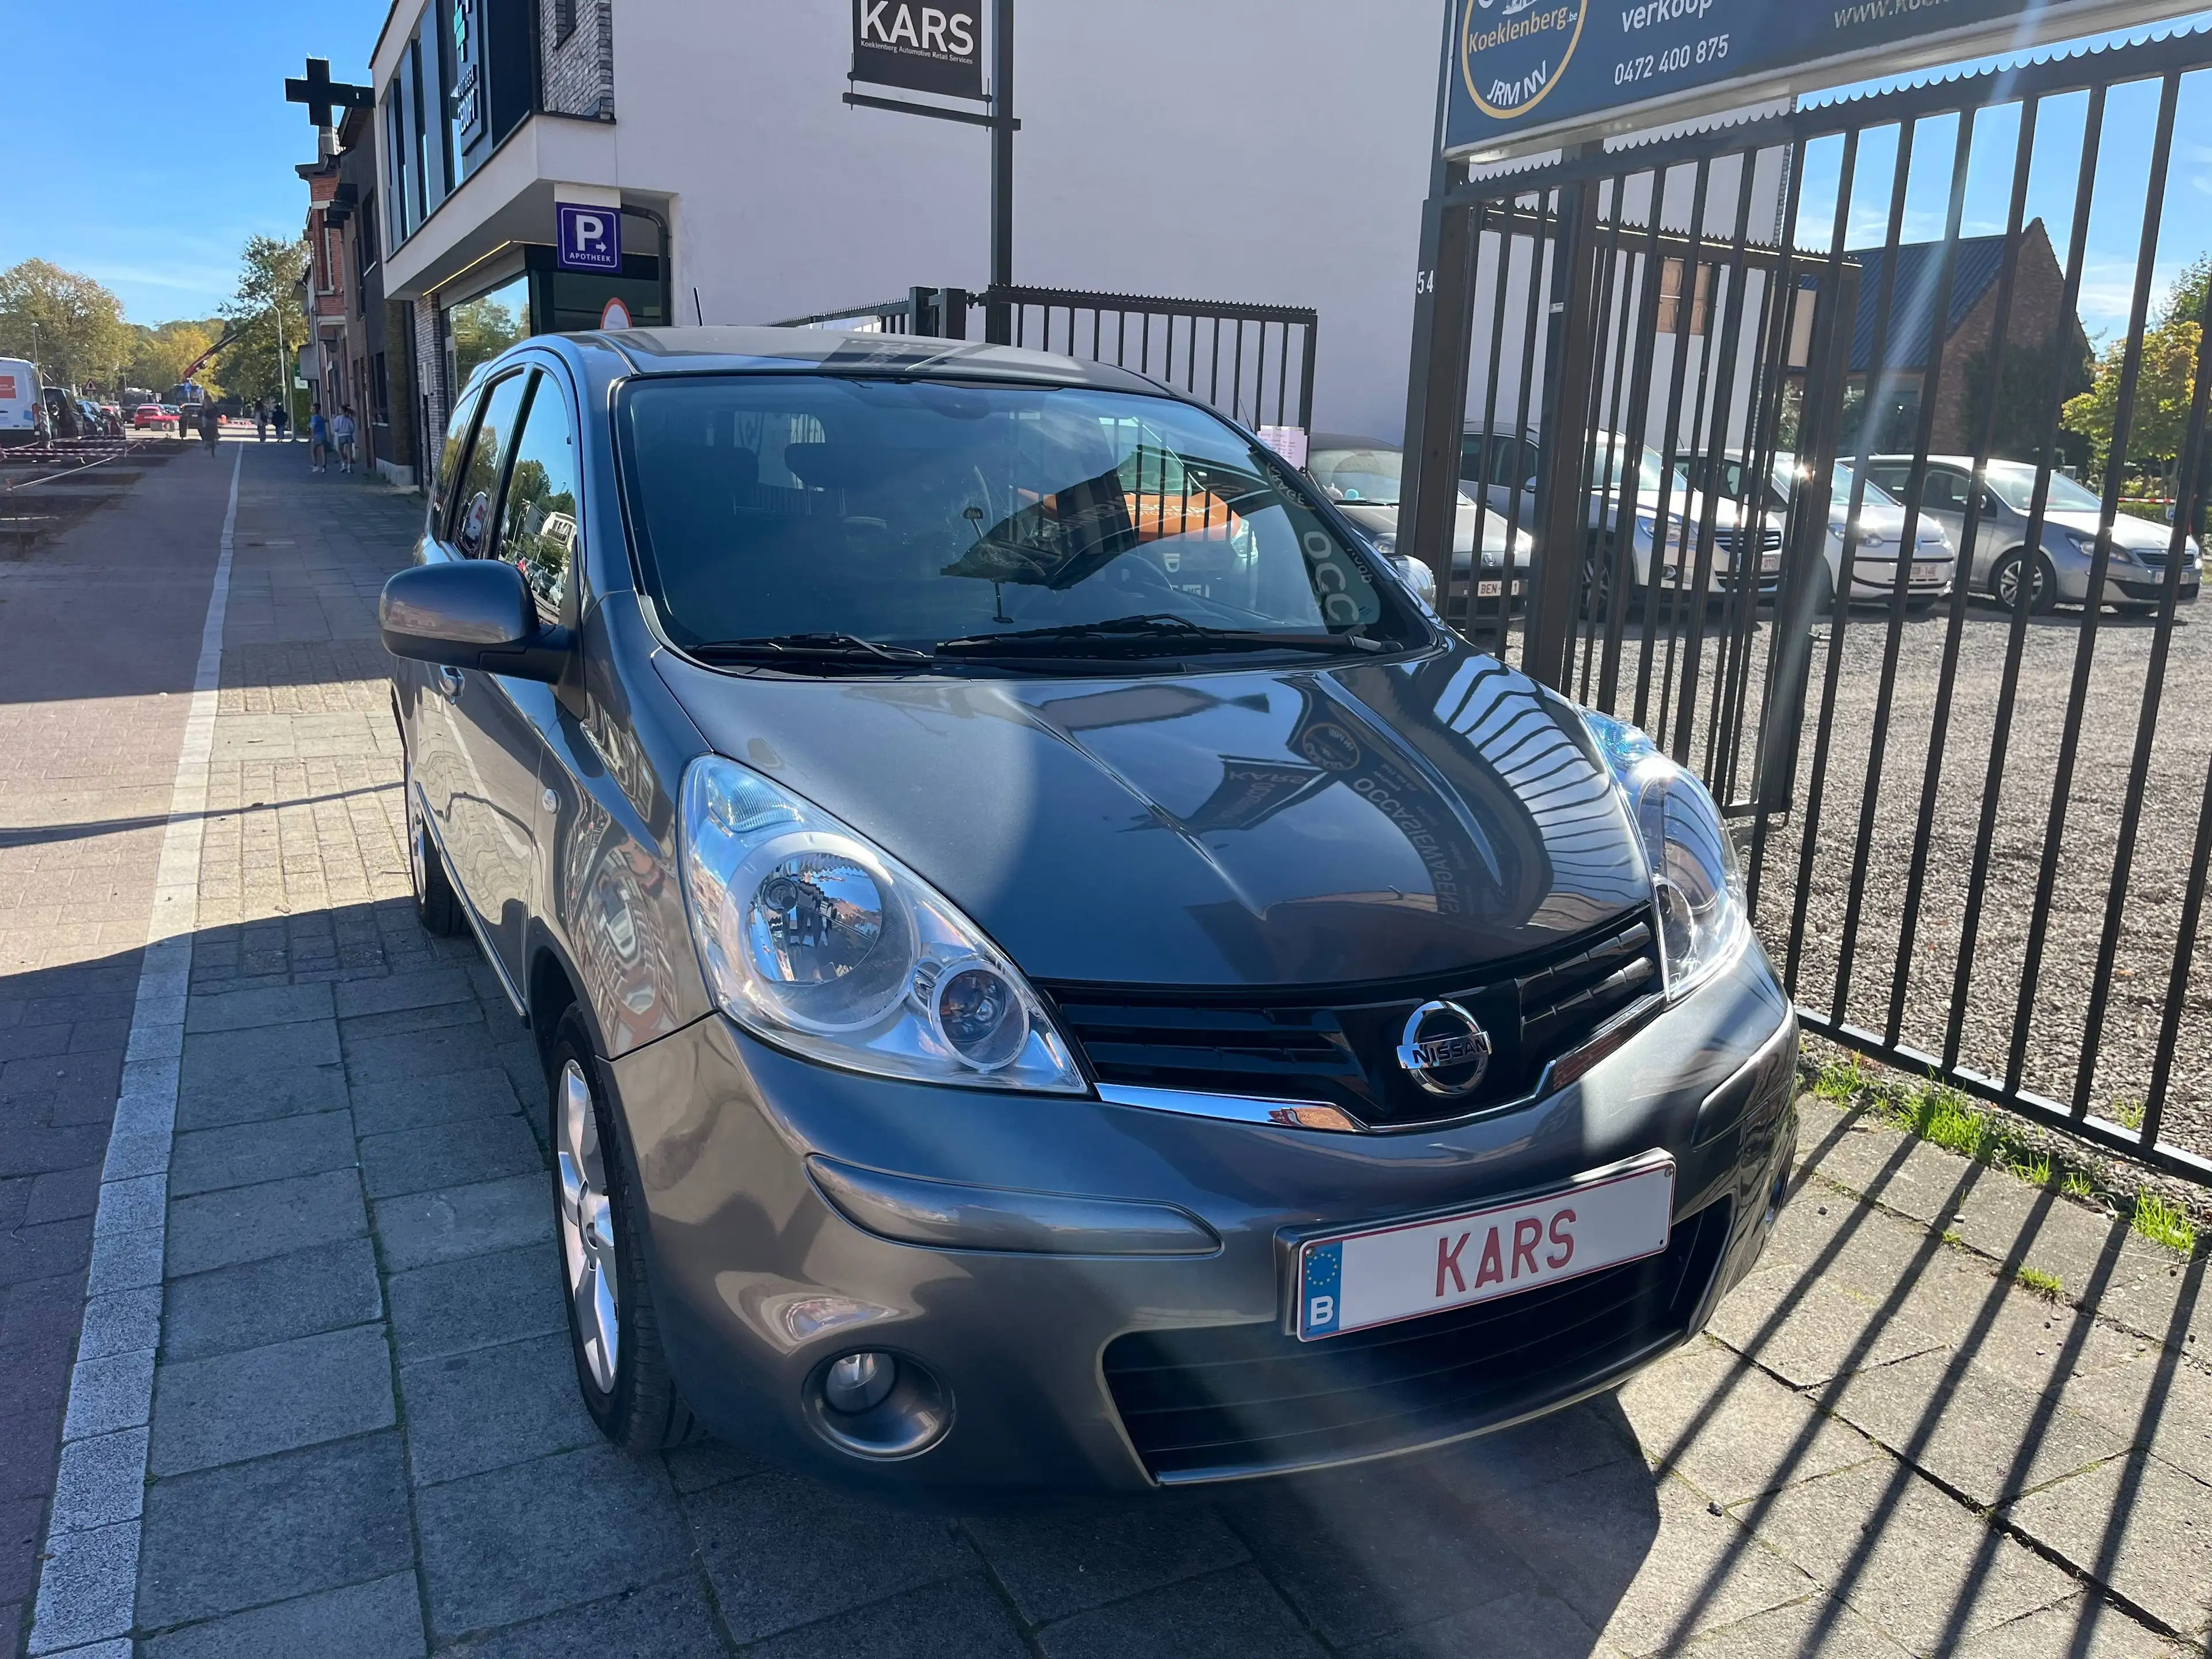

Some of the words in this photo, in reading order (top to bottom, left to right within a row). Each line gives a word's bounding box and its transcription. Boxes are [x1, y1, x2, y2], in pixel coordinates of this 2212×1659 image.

[861, 0, 974, 55] KARS
[1622, 0, 1713, 32] verkoop
[861, 40, 897, 54] Koeklenberg
[899, 46, 931, 58] Automotive
[932, 51, 948, 60] Retail
[949, 54, 973, 65] Services
[1614, 55, 1654, 85] 0472
[1658, 45, 1690, 73] 400
[1695, 34, 1729, 63] 875
[1487, 79, 1520, 106] JRM
[1524, 59, 1546, 99] NV
[576, 214, 603, 251] P
[570, 252, 611, 262] APOTHEEK
[1417, 270, 1434, 294] 54
[1412, 1039, 1488, 1063] NISSAN
[1435, 1209, 1577, 1297] KARS
[1310, 1295, 1335, 1327] B
